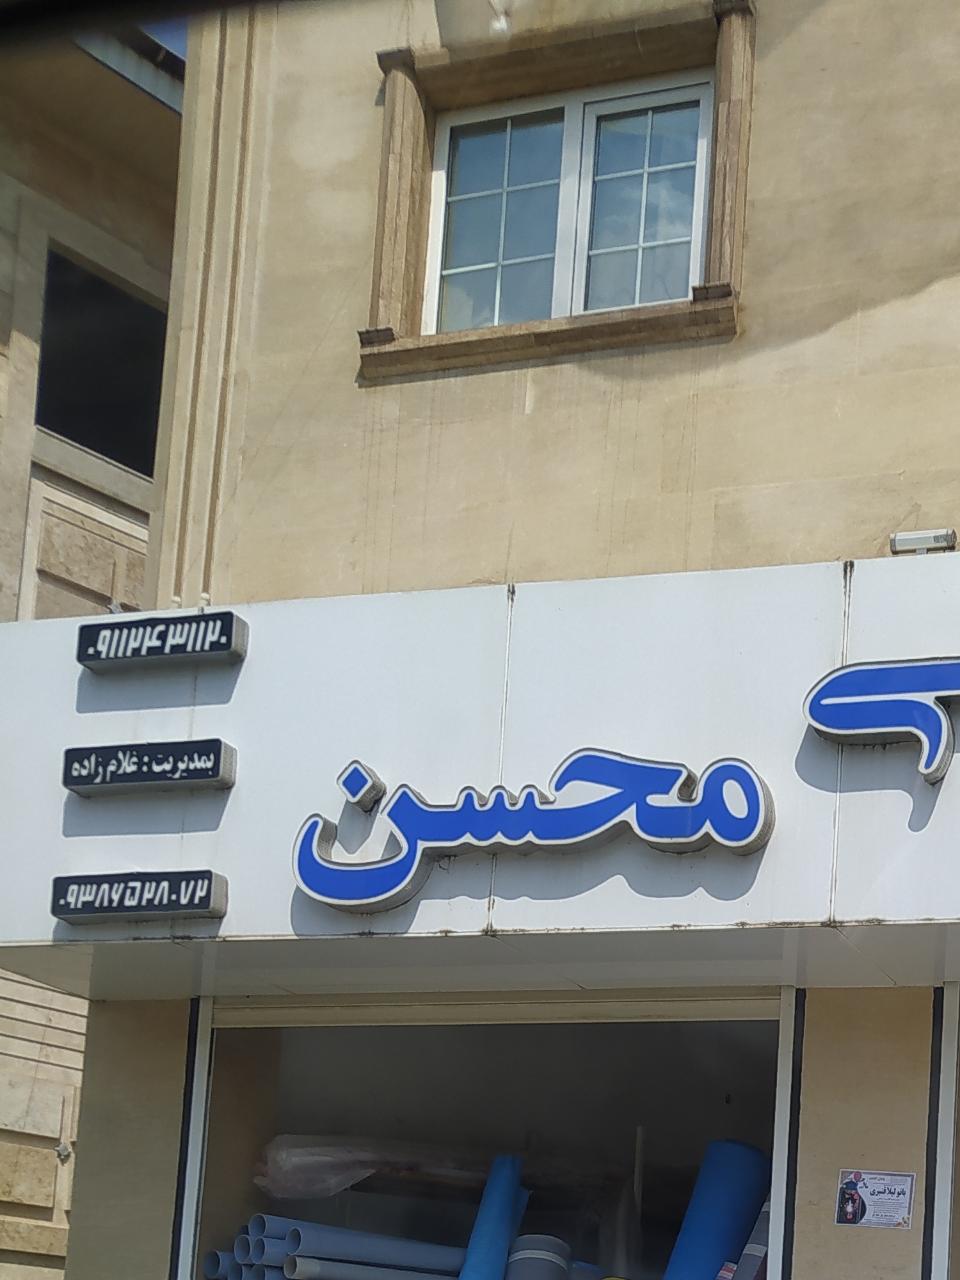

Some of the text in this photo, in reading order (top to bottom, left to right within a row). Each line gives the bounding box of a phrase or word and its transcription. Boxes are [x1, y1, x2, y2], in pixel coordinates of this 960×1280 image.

[71, 752, 104, 784] زاده
[105, 750, 139, 783] غلام
[293, 747, 772, 908] محسن
